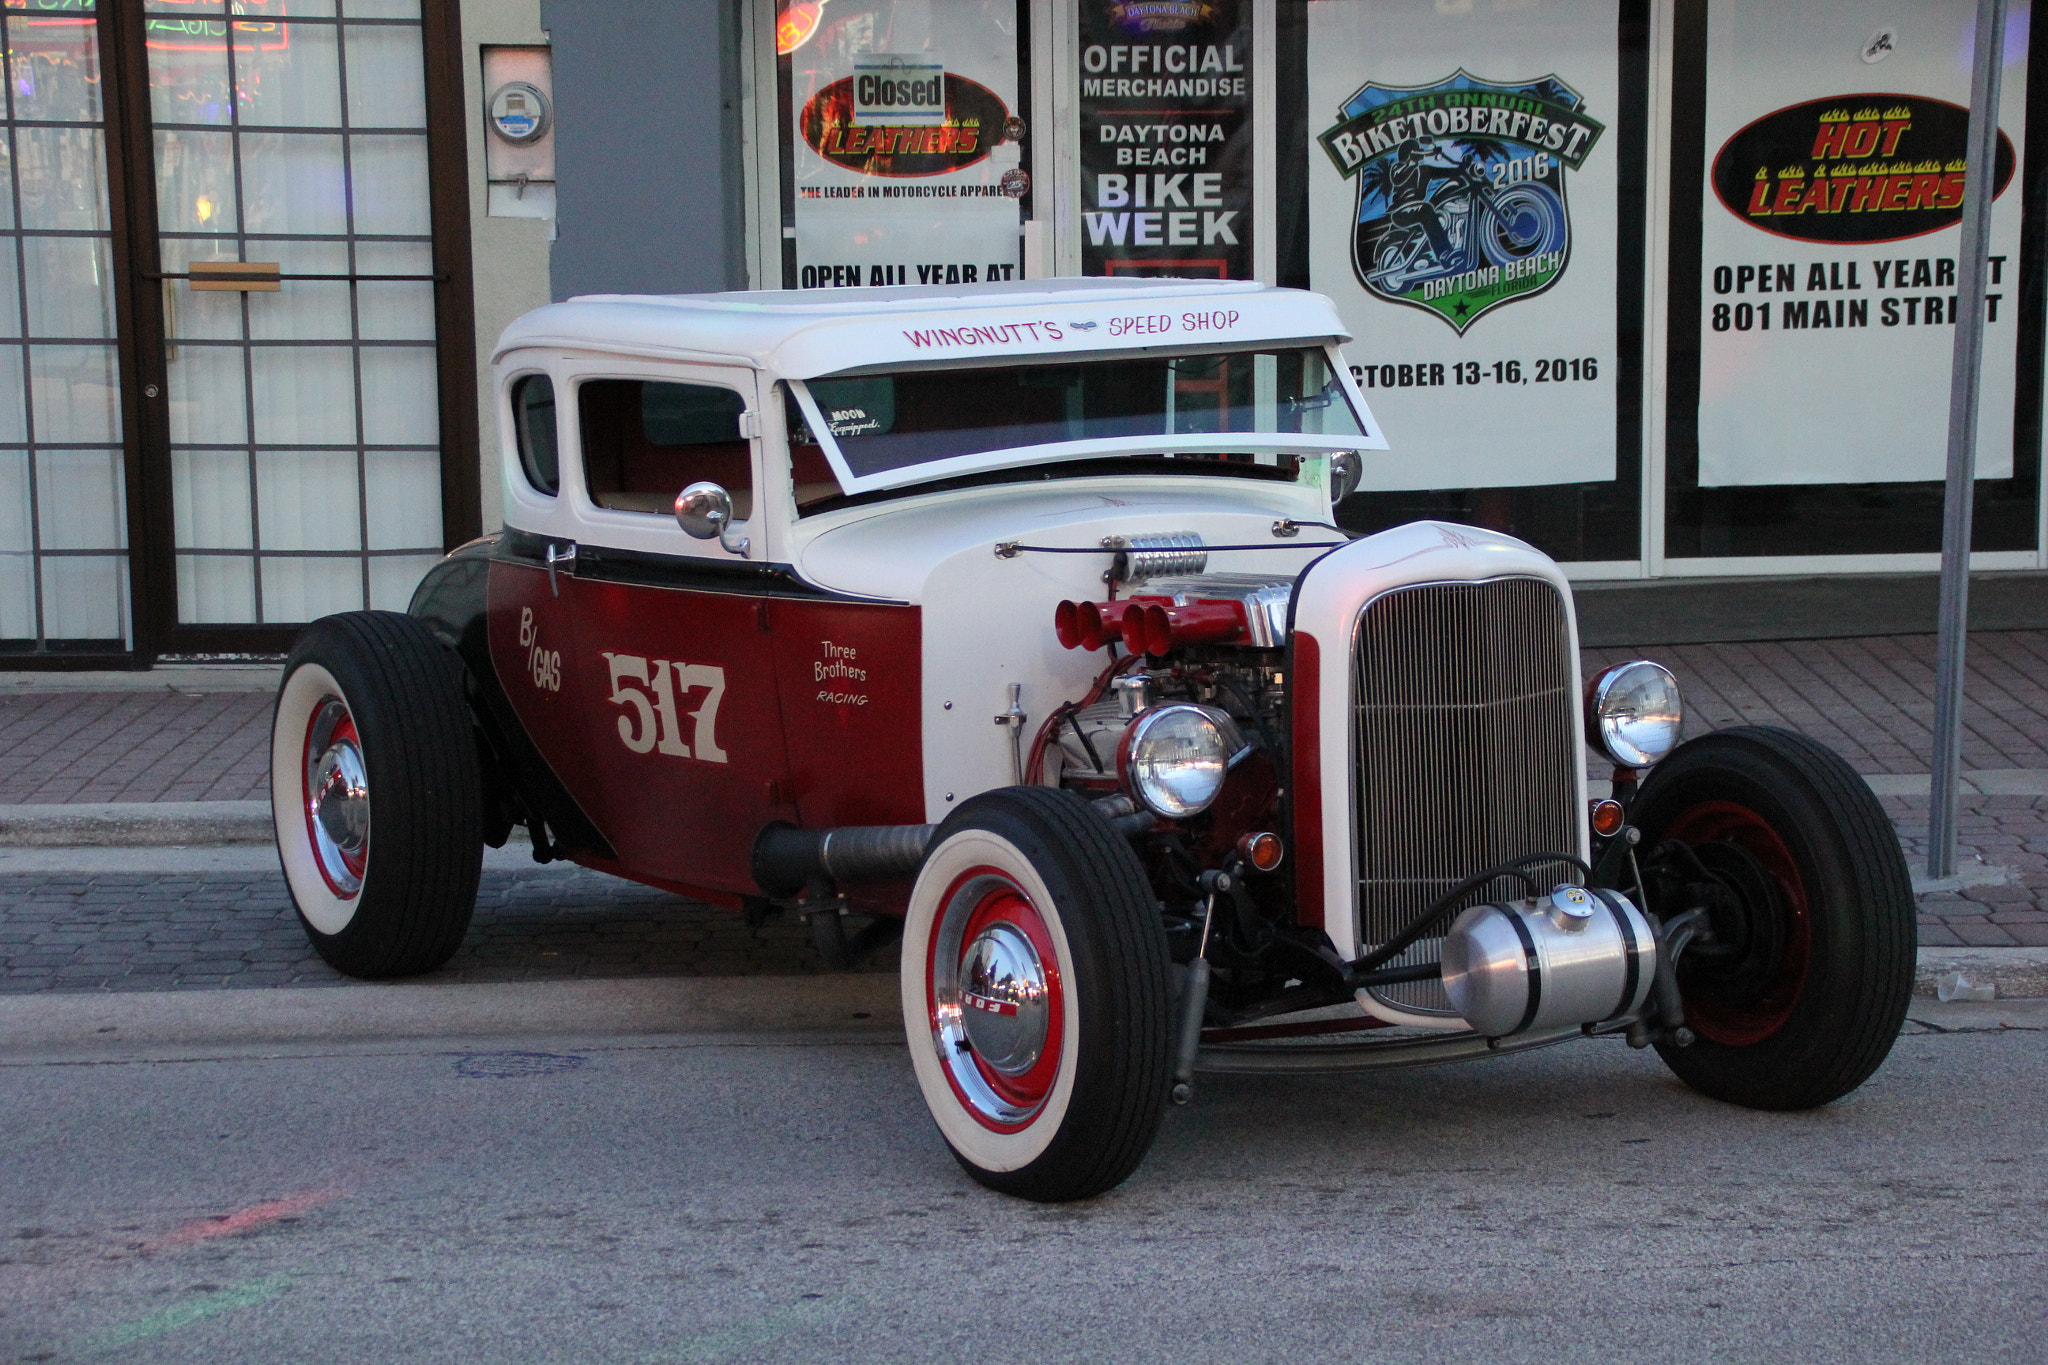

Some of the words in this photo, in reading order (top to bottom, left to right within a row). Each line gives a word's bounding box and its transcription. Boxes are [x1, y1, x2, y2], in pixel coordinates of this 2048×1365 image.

[1128, 5, 1168, 17] DAYTONA
[1169, 5, 1199, 17] BEACH
[1083, 45, 1244, 73] OFFICIAL
[858, 75, 942, 107] Closed
[1083, 78, 1246, 97] MERCHANDISE
[1371, 98, 1436, 125] 24TH
[1445, 92, 1546, 118] ANNUAL
[830, 124, 980, 154] LEATHERS
[1100, 124, 1226, 143] DAYTONA
[1332, 106, 1591, 169] BIKETOBERFEST
[1811, 116, 1912, 160] HOT
[1116, 147, 1206, 166] BEACH
[1492, 152, 1550, 190] 2016
[801, 187, 821, 198] THE
[825, 186, 865, 198] LEADER
[868, 186, 880, 198] IN
[883, 185, 957, 198] MOTORCYCLE
[1098, 173, 1223, 208] BIKE
[1747, 172, 1967, 216] LEATHERS
[1085, 211, 1240, 246] WEEK
[801, 265, 861, 289] OPEN
[986, 263, 1015, 282] AT
[1423, 265, 1500, 301] DAYTONA
[1505, 251, 1561, 281] BEACH
[1491, 276, 1538, 296] FLORIDA
[1713, 263, 1796, 294] OPEN
[1807, 261, 1861, 291] ALL
[1872, 258, 1955, 289] YEAR
[1712, 301, 1771, 332] 801
[1782, 298, 1868, 330] MAIN
[1881, 293, 2003, 327] STRT
[903, 320, 1064, 348] WINGNUTT'S
[1109, 315, 1171, 336] SPEED
[1182, 310, 1240, 331] SHOP
[1349, 363, 1445, 388] CTOBER
[1452, 360, 1528, 385] 13-16,
[1535, 357, 1599, 382] 2016
[831, 409, 866, 421] MOON
[821, 641, 856, 660] Three
[814, 659, 867, 682] Brothers
[601, 652, 728, 763] 517
[816, 691, 868, 705] RACING
